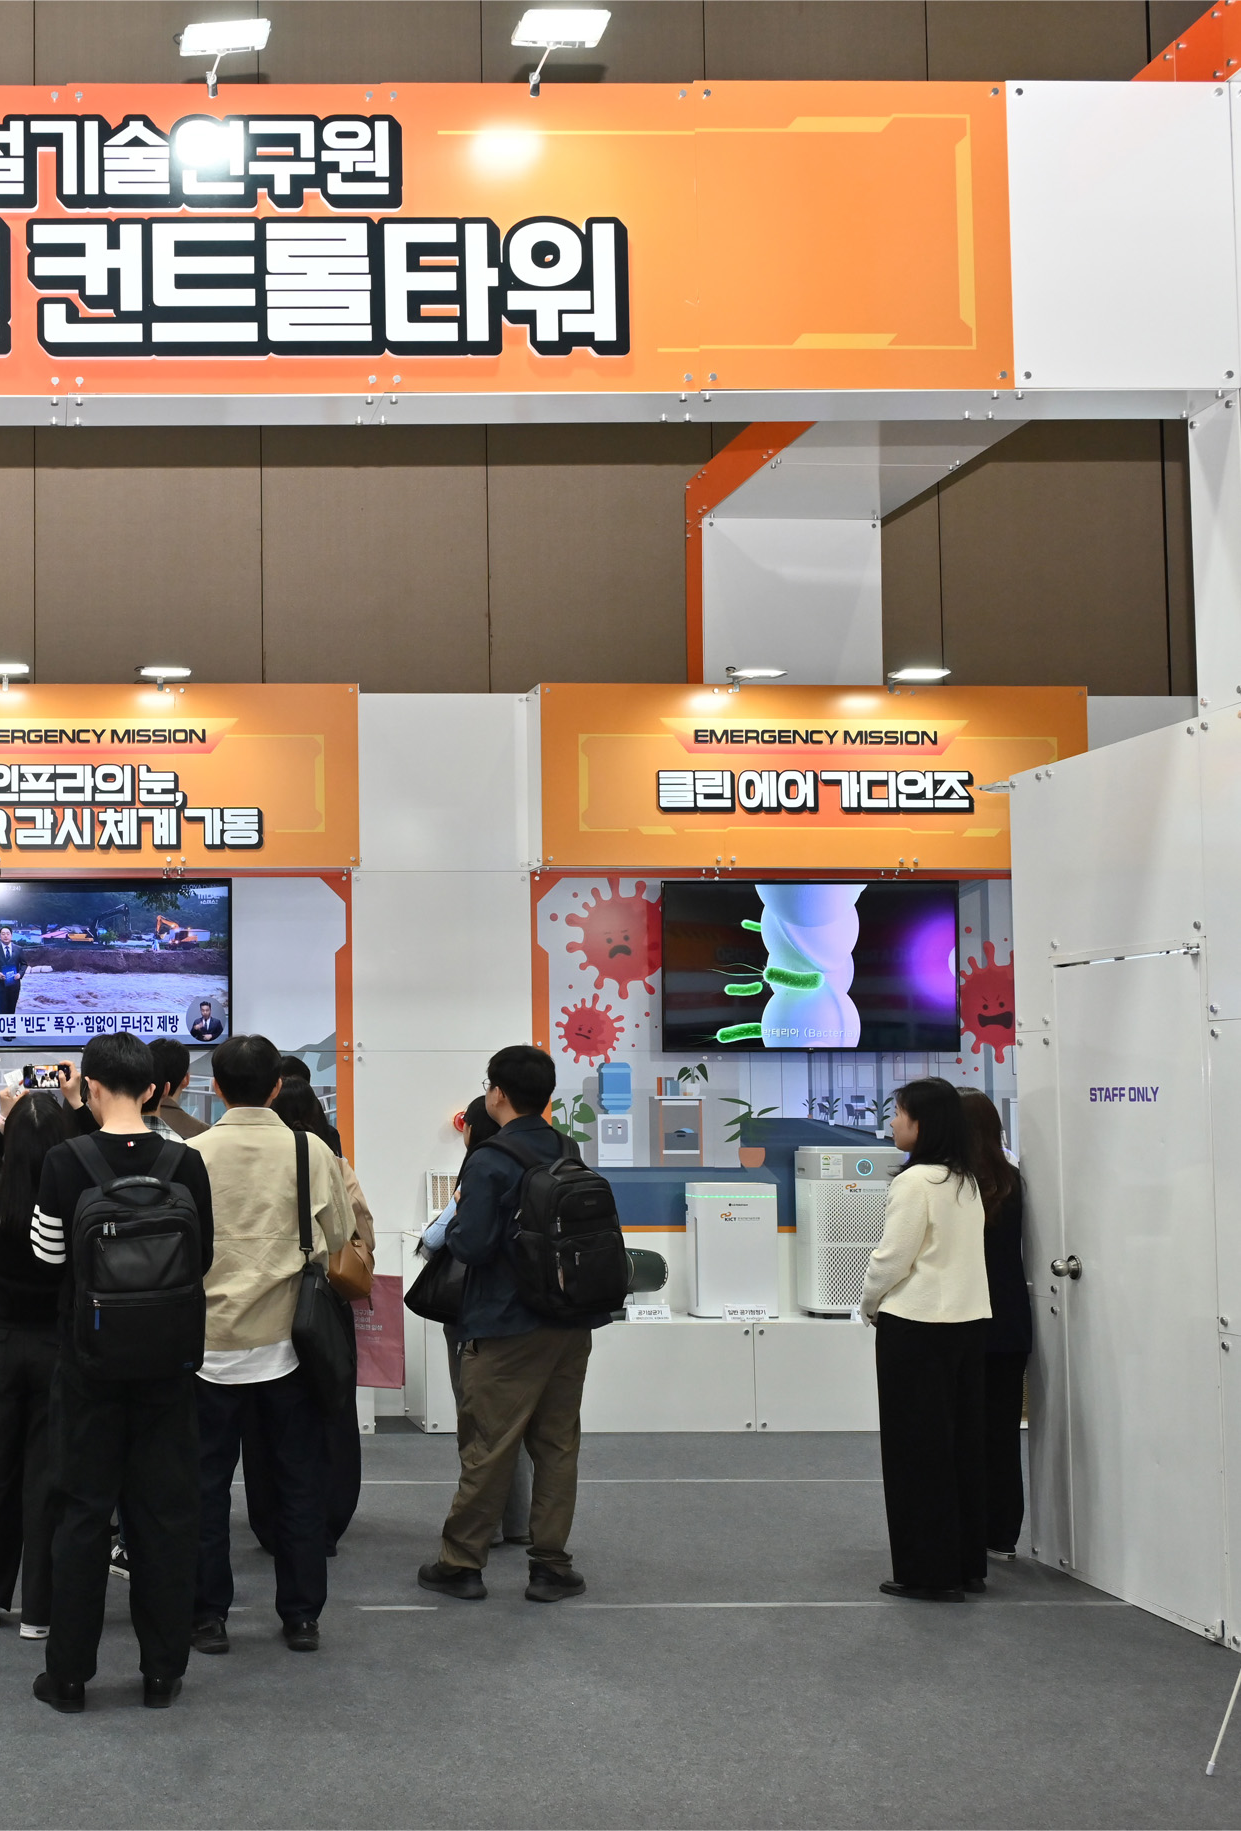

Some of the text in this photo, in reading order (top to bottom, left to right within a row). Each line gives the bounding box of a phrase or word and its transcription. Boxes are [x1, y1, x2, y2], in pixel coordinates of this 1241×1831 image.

[29, 219, 619, 345] 컨트롤타워
[110, 728, 208, 745] MISSION
[694, 728, 938, 746] EMERGENCY MISSION
[138, 764, 185, 808] 눈,
[658, 770, 970, 809] 클린 에어 가디언즈
[15, 808, 92, 846] 감시
[98, 808, 178, 846] 체계
[184, 808, 261, 846] 가동
[20, 1016, 51, 1033] '빈도'
[121, 1015, 154, 1033] 무너진
[157, 1015, 180, 1033] 제방
[1089, 1086, 1159, 1102] STAFF ONLY
